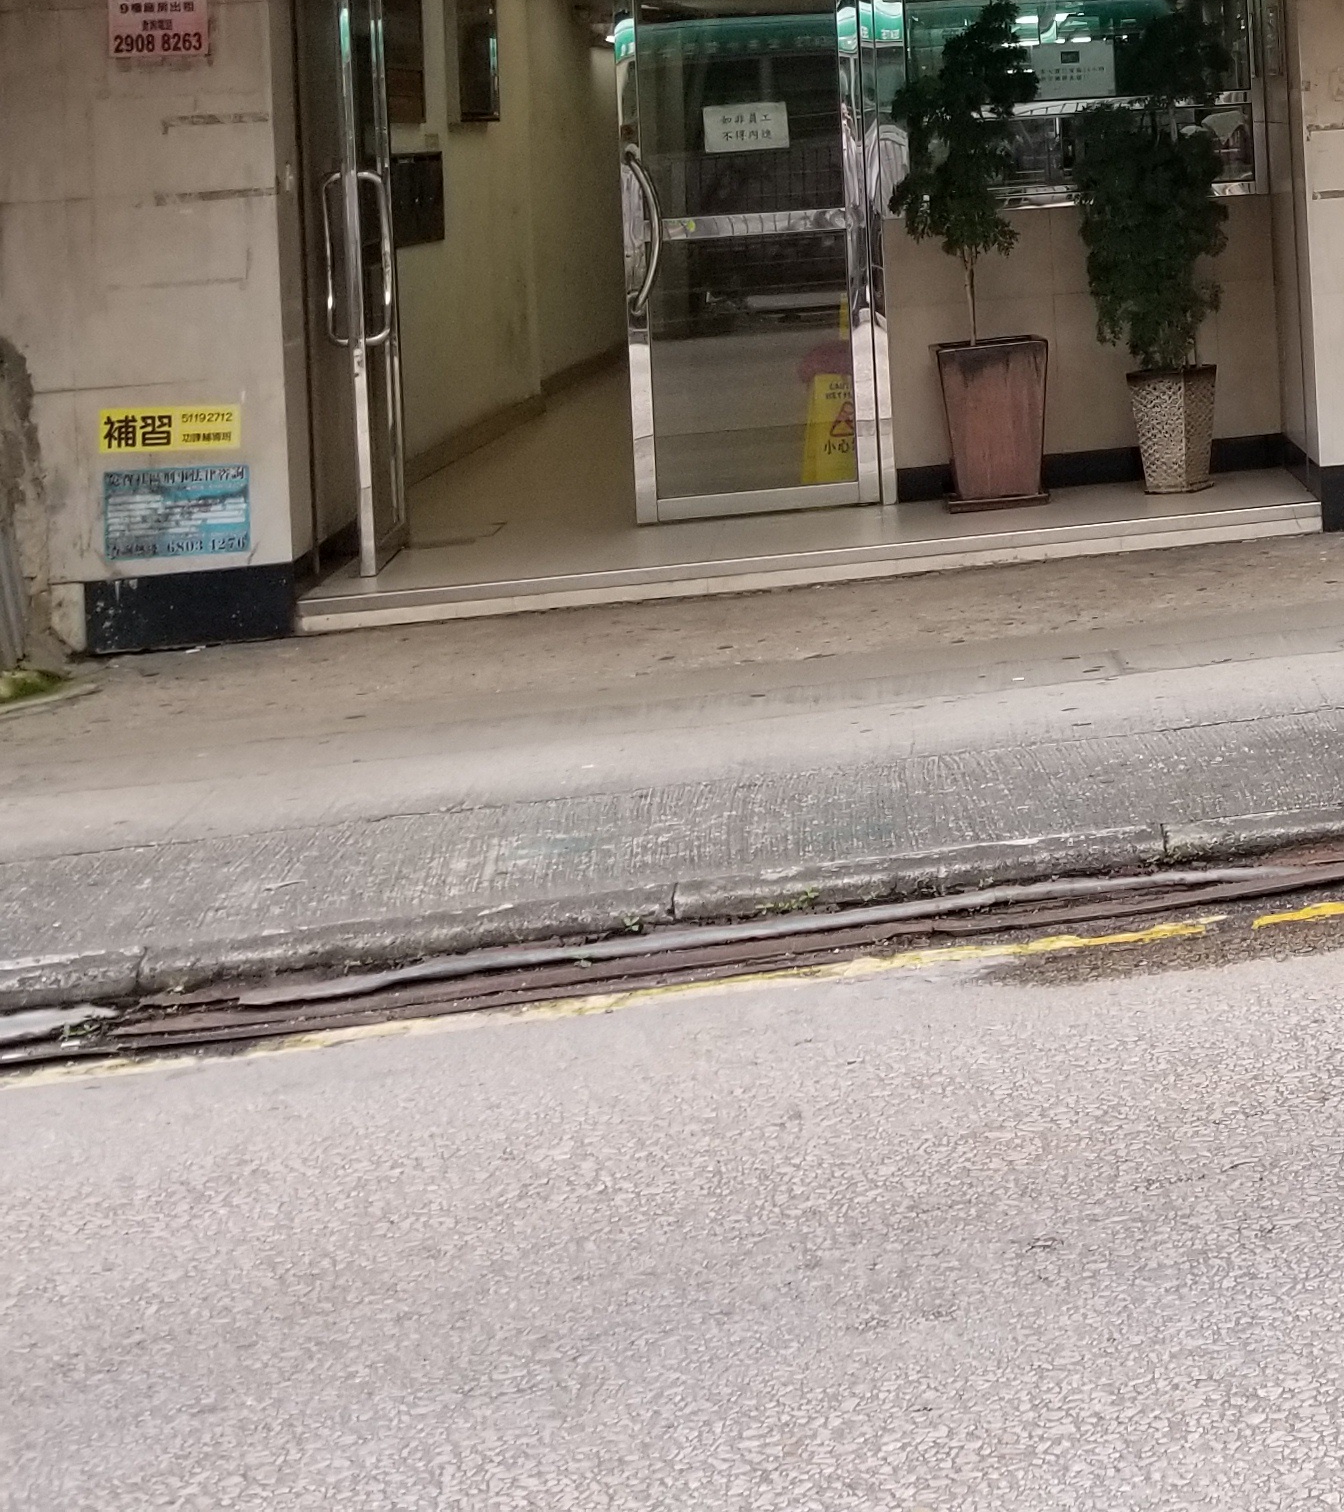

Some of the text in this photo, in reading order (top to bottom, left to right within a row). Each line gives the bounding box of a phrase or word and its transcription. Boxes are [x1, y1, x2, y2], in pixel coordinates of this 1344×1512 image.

[113, 32, 203, 54] 2908 8263
[181, 411, 233, 423] 51192712
[103, 414, 173, 449] 補習
